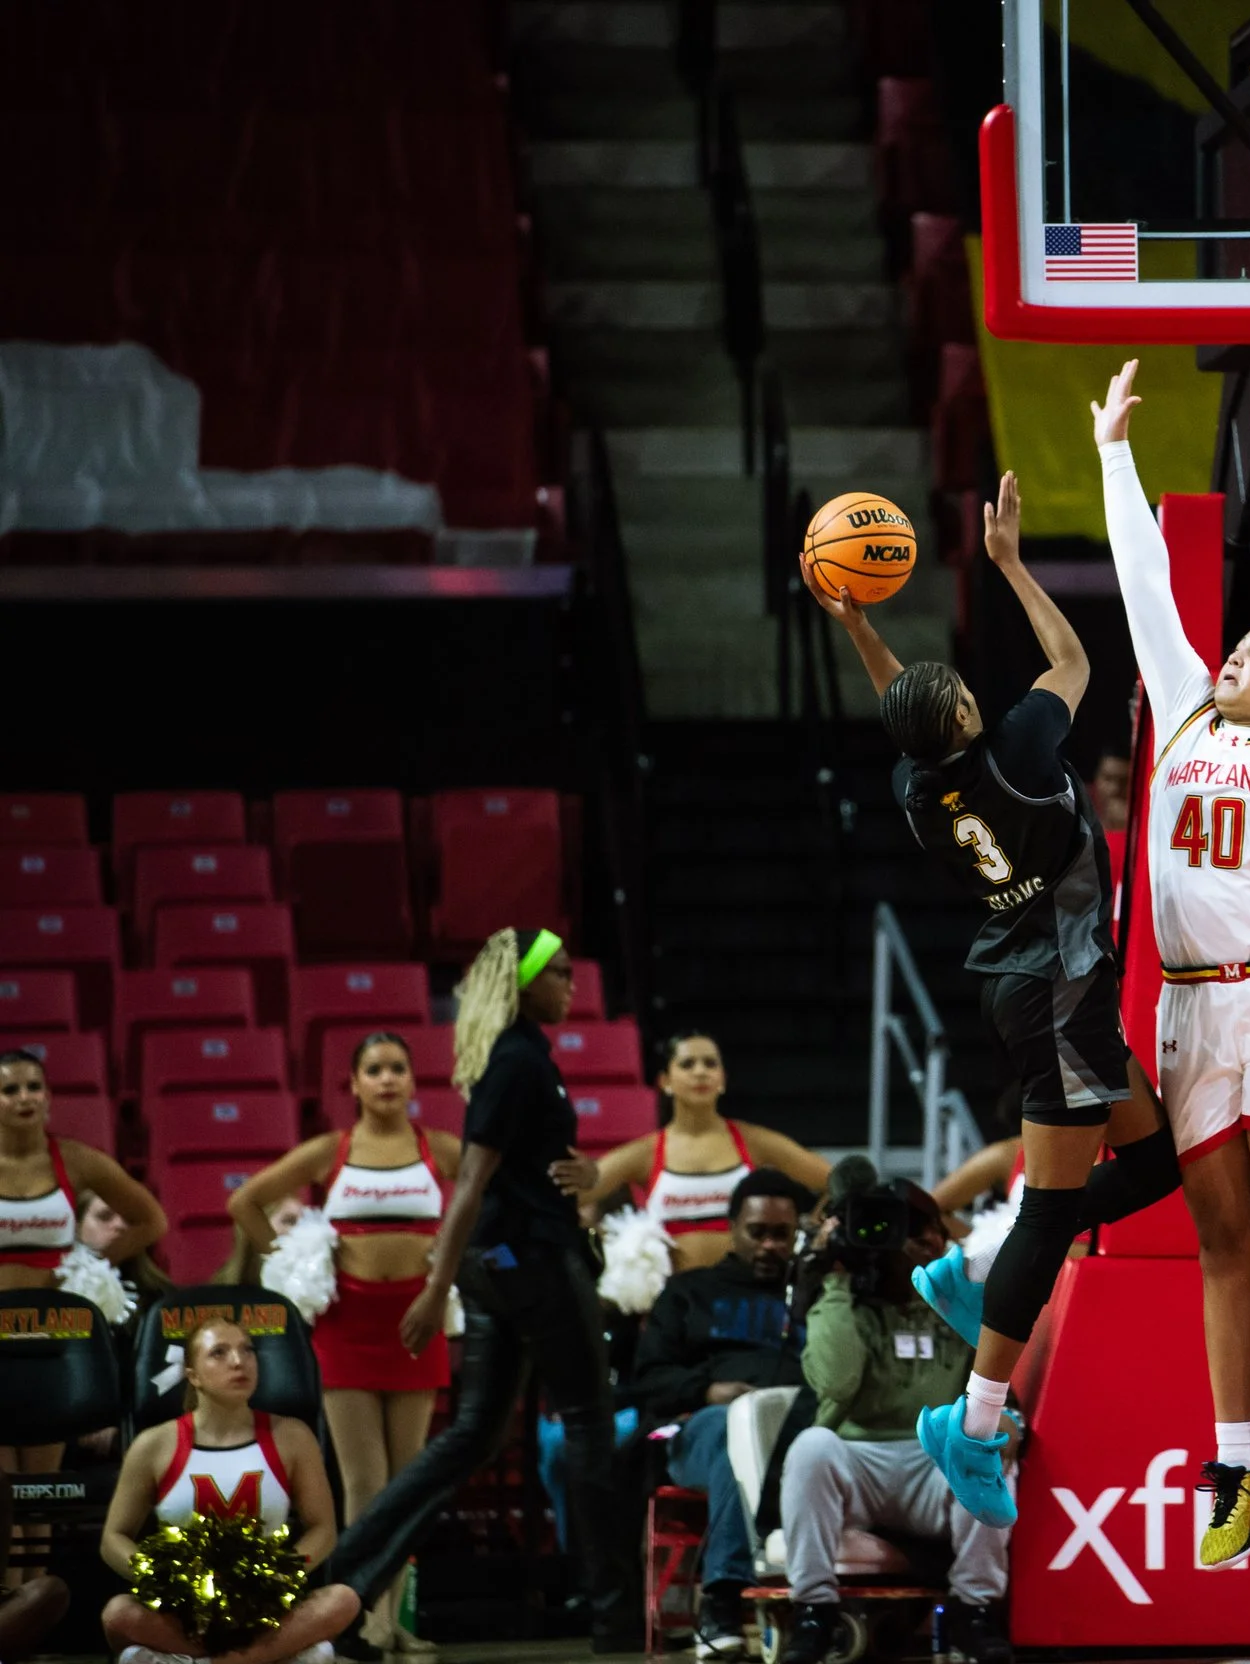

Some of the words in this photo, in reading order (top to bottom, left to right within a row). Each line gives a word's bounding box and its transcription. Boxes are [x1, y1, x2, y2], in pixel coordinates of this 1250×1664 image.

[846, 508, 912, 531] Wilson
[863, 544, 910, 562] NCAA
[953, 813, 1013, 884] 3
[1170, 795, 1245, 869] 40
[1223, 963, 1241, 979] M
[190, 1471, 264, 1523] M
